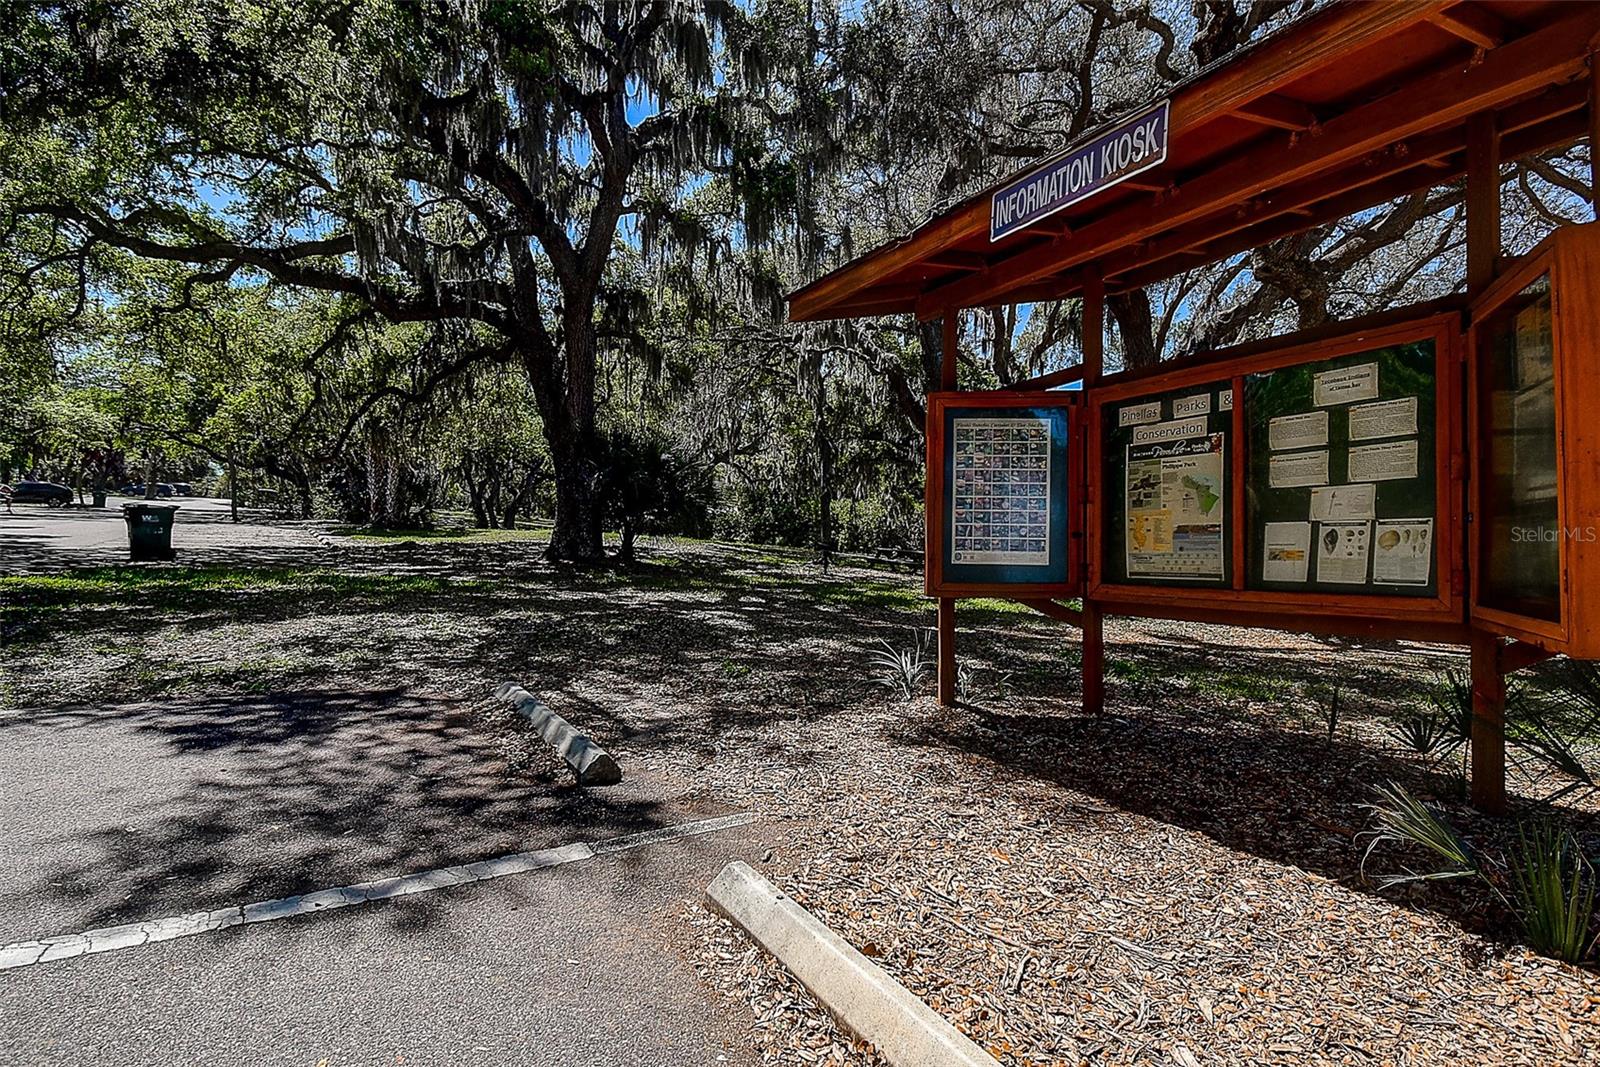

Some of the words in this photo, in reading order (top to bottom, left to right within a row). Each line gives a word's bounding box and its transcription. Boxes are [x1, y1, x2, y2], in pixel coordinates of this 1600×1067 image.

[995, 152, 1095, 229] INFORMATION
[1100, 117, 1160, 179] KIOSK
[1122, 407, 1158, 422] Pinellas
[1176, 399, 1207, 413] Parks
[1136, 423, 1203, 441] Conservation
